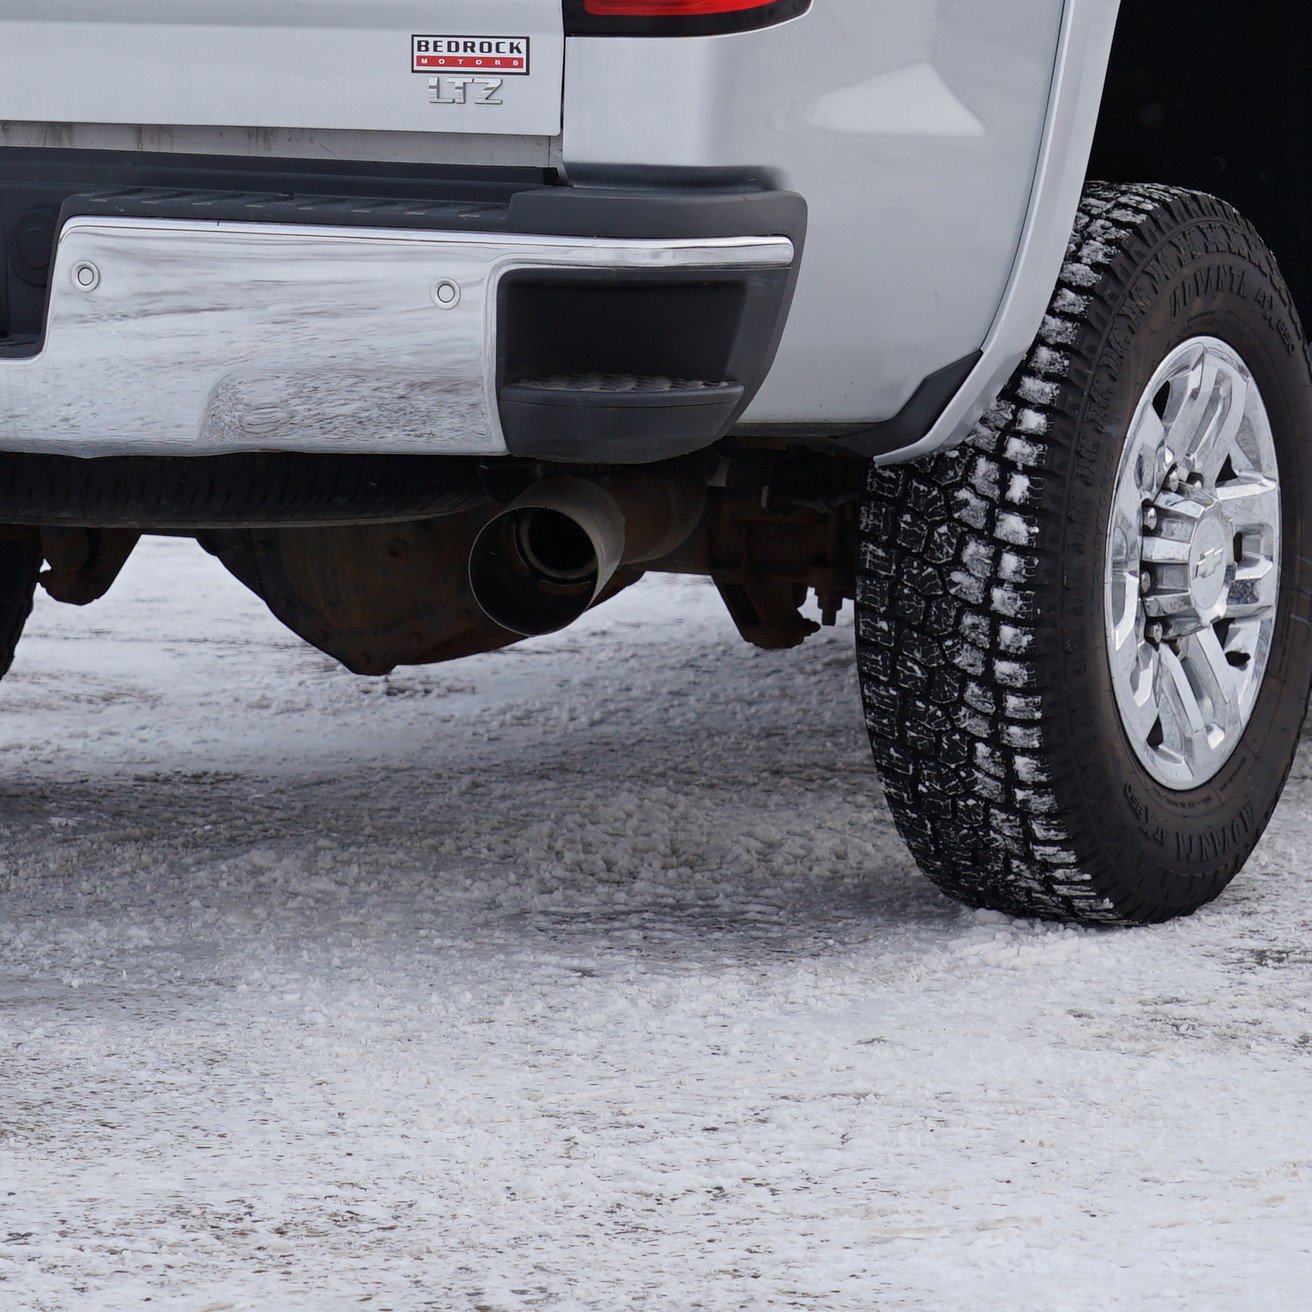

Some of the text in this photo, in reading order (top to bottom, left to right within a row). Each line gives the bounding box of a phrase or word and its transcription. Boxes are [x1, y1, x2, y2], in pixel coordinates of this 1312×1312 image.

[417, 40, 523, 54] BEDROCK
[421, 58, 519, 66] MOTORS
[429, 77, 503, 105] LTZ
